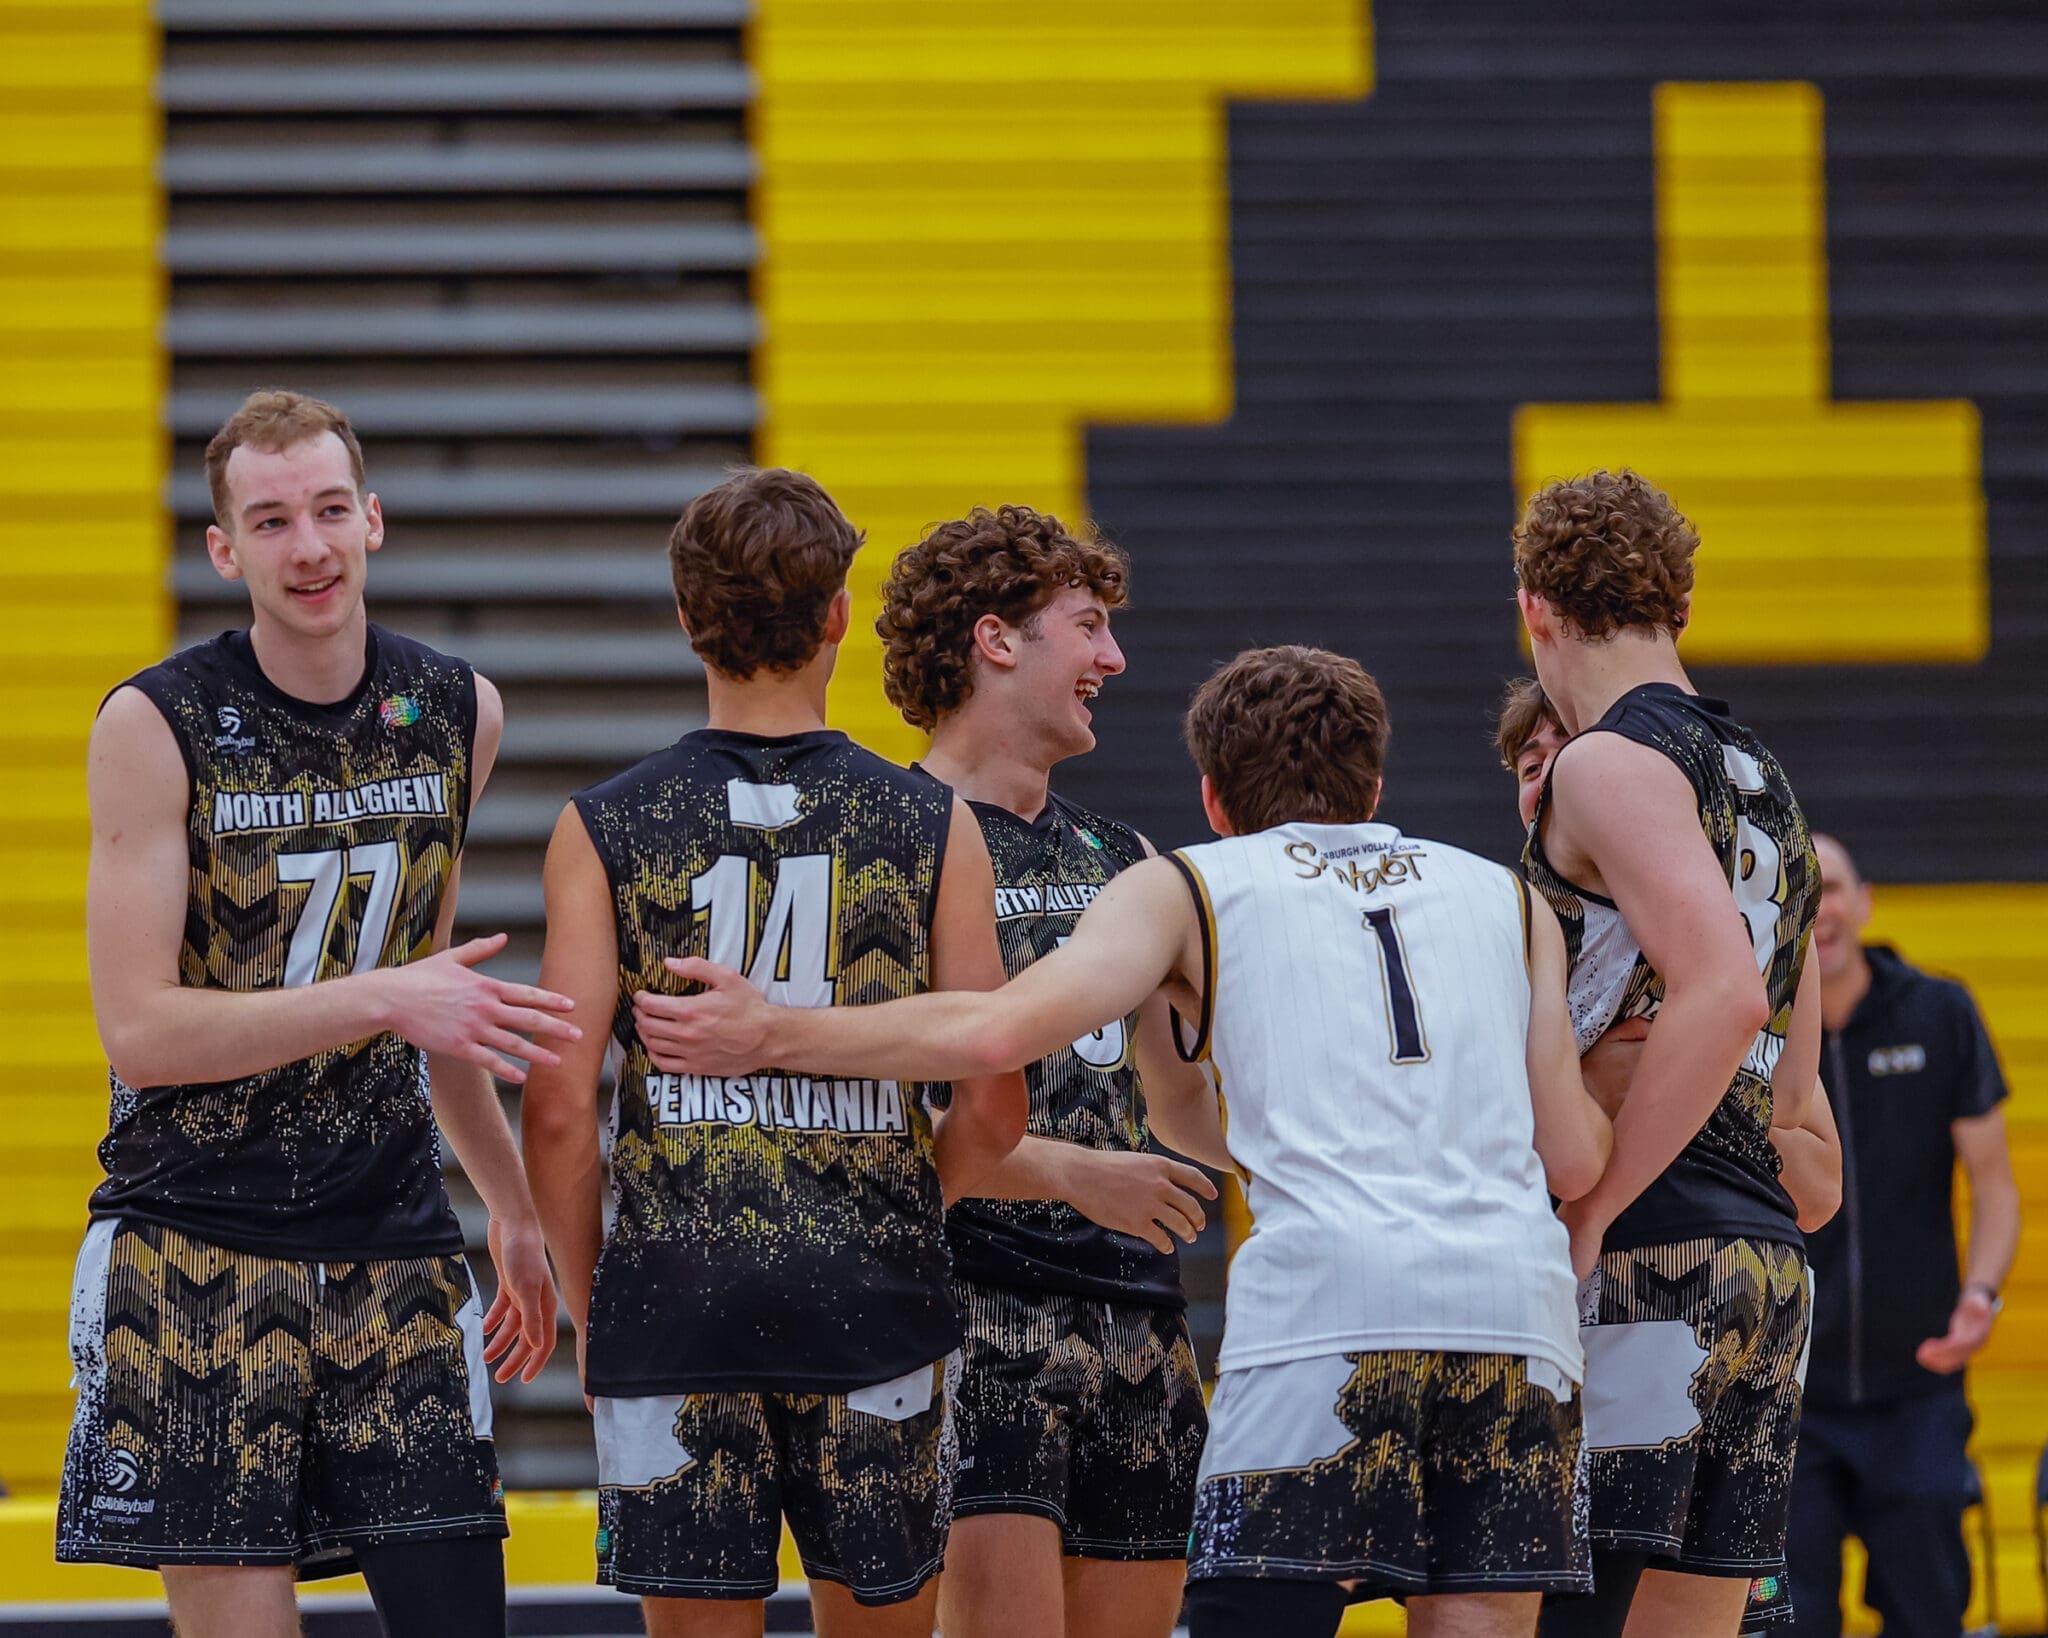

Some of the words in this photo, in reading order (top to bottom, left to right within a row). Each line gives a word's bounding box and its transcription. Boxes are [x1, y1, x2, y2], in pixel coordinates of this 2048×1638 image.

[213, 791, 305, 834] NORTH
[314, 773, 447, 823] ALLGHENY
[276, 840, 400, 988] 77
[691, 853, 834, 1008] 14
[995, 886, 1042, 918] RTH
[1361, 904, 1431, 1064] 1
[646, 1073, 905, 1133] PENNSYLVANIA
